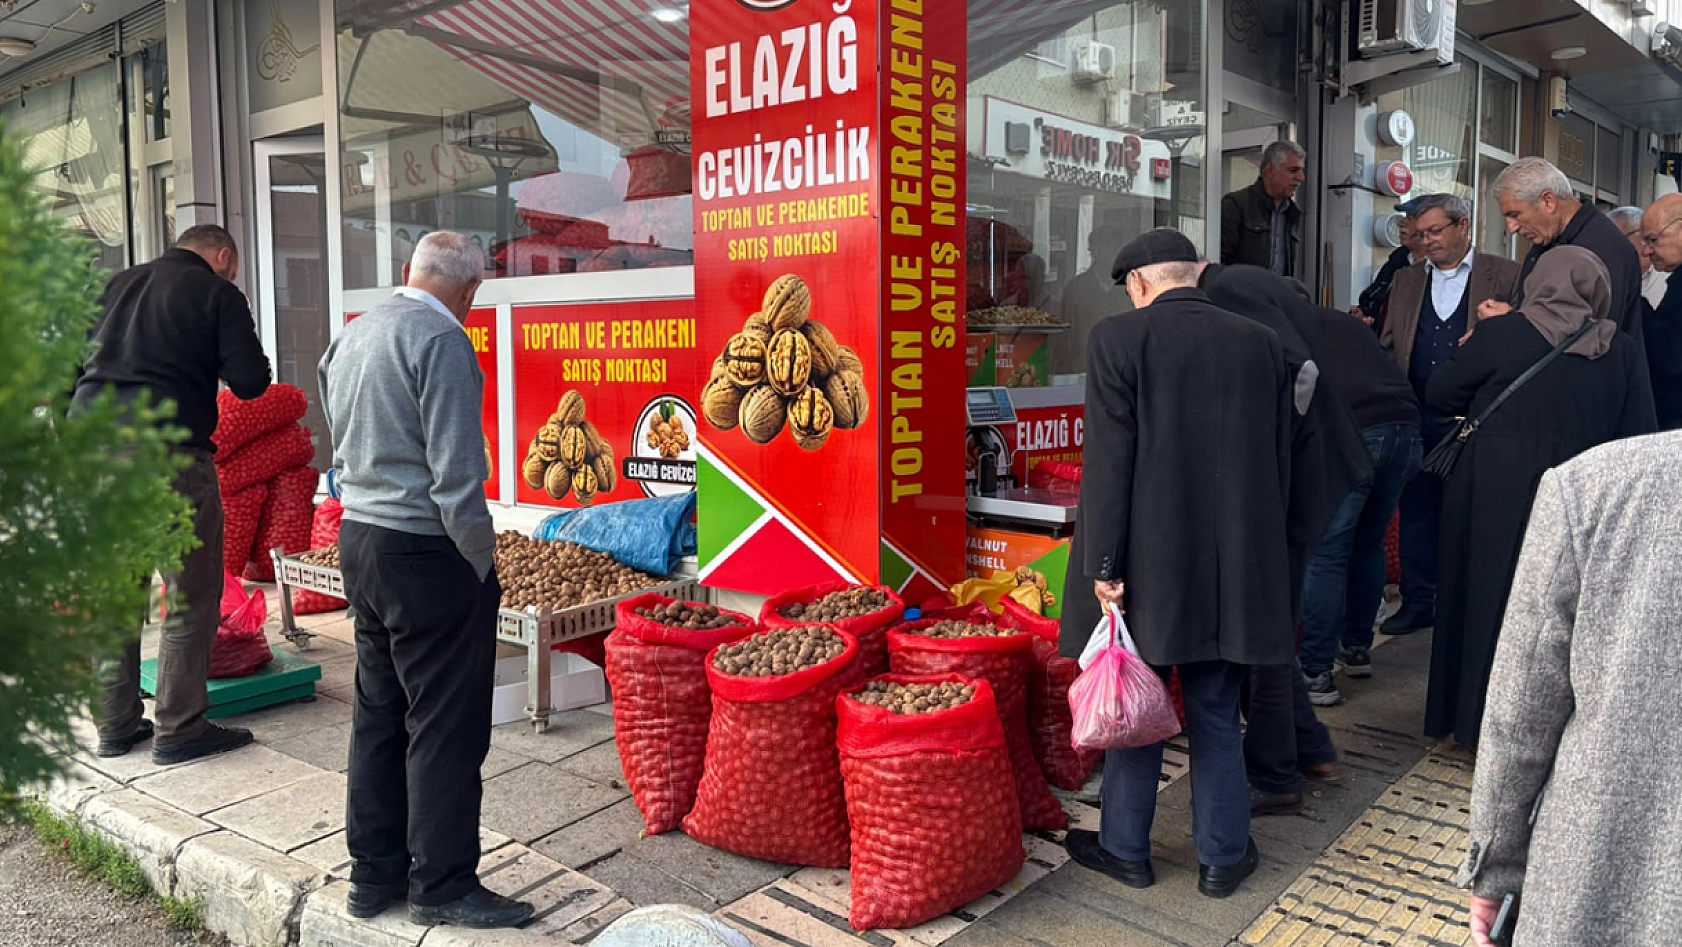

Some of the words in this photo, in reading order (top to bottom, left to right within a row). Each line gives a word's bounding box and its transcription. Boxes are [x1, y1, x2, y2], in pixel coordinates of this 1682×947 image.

[705, 0, 858, 118] ELAZIĞ
[698, 119, 870, 200] CEVİZCİLİK
[931, 59, 957, 226] NOKTASI
[702, 206, 752, 232] TOPTAN
[757, 203, 774, 226] VE
[779, 193, 869, 225] PERAKENDE
[728, 236, 769, 263] SATIŞ
[773, 230, 838, 257] NOKTASI
[891, 255, 923, 311] VE
[931, 241, 961, 349] SATIŞ
[522, 322, 580, 350] TOPTAN
[586, 321, 606, 349] VE
[562, 359, 602, 386] SATIŞ
[605, 358, 667, 383] NOKTASI
[891, 330, 923, 504] TOPTAN
[1017, 413, 1069, 451] ELAZIĞ
[628, 461, 659, 480] ELAZIĞ
